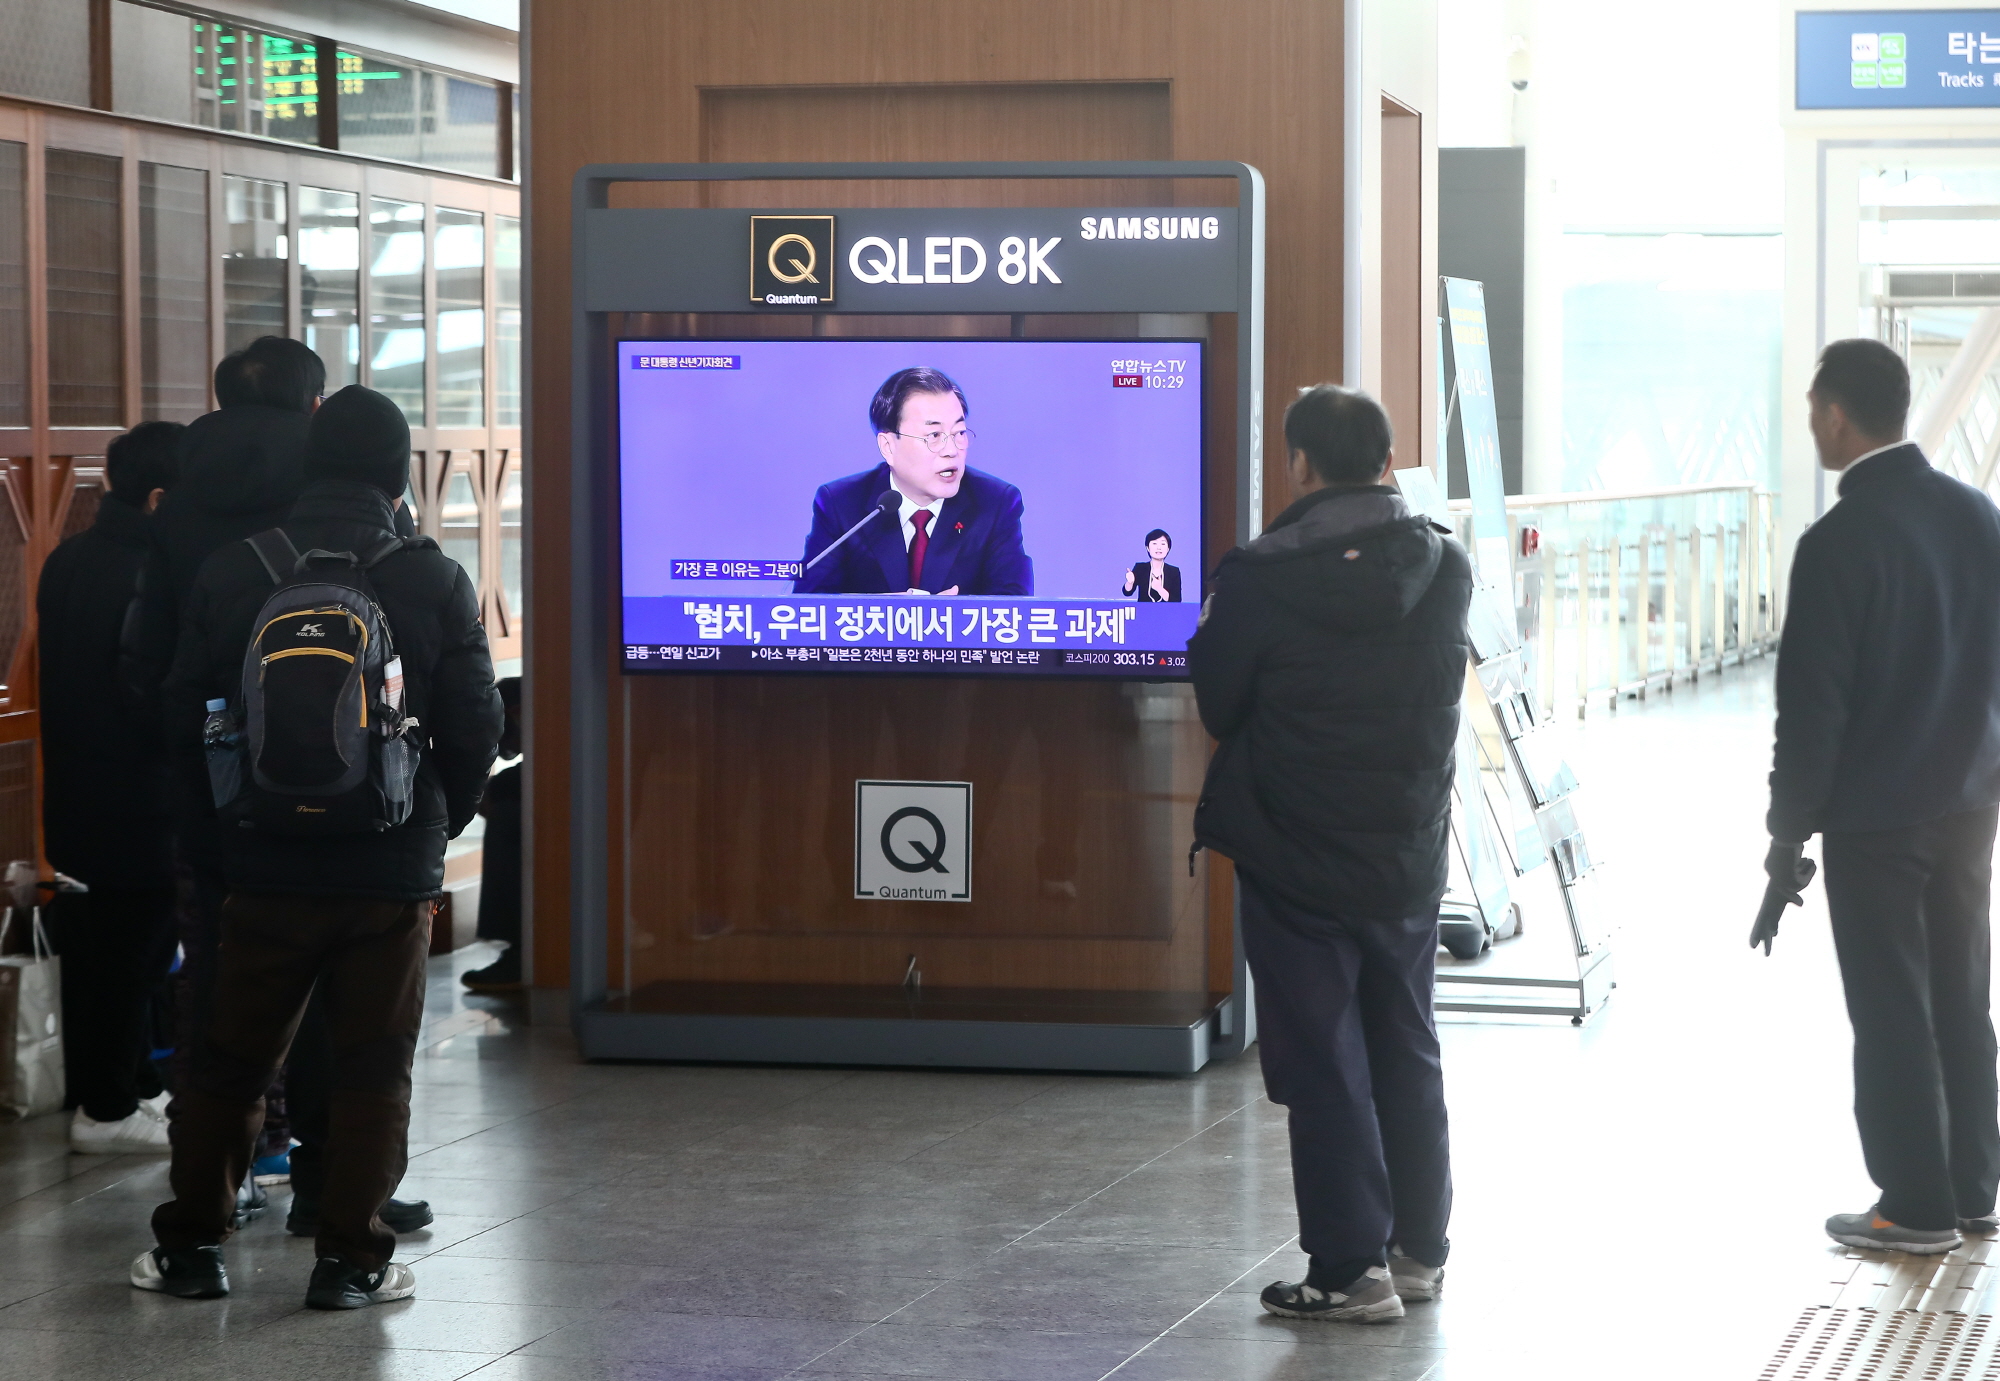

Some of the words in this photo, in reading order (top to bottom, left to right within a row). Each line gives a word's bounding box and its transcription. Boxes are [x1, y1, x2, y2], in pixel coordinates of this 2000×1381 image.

[1948, 32, 2000, 64] 타는
[1937, 71, 1984, 87] Tracks
[1080, 216, 1220, 240] SAMSUNG
[767, 233, 820, 284] Q
[848, 236, 987, 284] QLED
[997, 236, 1063, 285] 8K
[765, 293, 818, 305] Quantum
[640, 357, 650, 368] 문
[650, 357, 678, 368] 대통령
[679, 357, 733, 368] 신년기자회견
[1110, 359, 1187, 374] 연합뉴스TV
[1118, 377, 1137, 386] LIVE
[1145, 375, 1184, 389] 10:29
[674, 562, 701, 577] 가장
[704, 563, 718, 577] 큰
[721, 563, 760, 578] 이유는
[764, 563, 803, 578] 그분이
[683, 602, 761, 644] "협치,
[768, 604, 826, 641] 우리
[834, 605, 953, 642] 정치에서
[961, 606, 1022, 643] 가장
[1028, 608, 1058, 643] 큰
[1065, 607, 1136, 645] 과제"
[685, 647, 721, 660] 신고가
[759, 647, 784, 661] 아소
[785, 647, 820, 661] 부총리
[823, 647, 862, 662] "일본은
[864, 648, 893, 662] 2천년
[896, 649, 919, 663] 동안
[922, 649, 957, 663] 하나의
[960, 649, 987, 664] 민족"
[990, 650, 1013, 664] 발언
[1016, 651, 1040, 664] 논란
[1065, 652, 1110, 665] 코스피200
[1113, 653, 1155, 665] 303.15
[1167, 657, 1186, 667] 3.02
[880, 806, 950, 873] Q
[879, 886, 946, 899] Quantum
